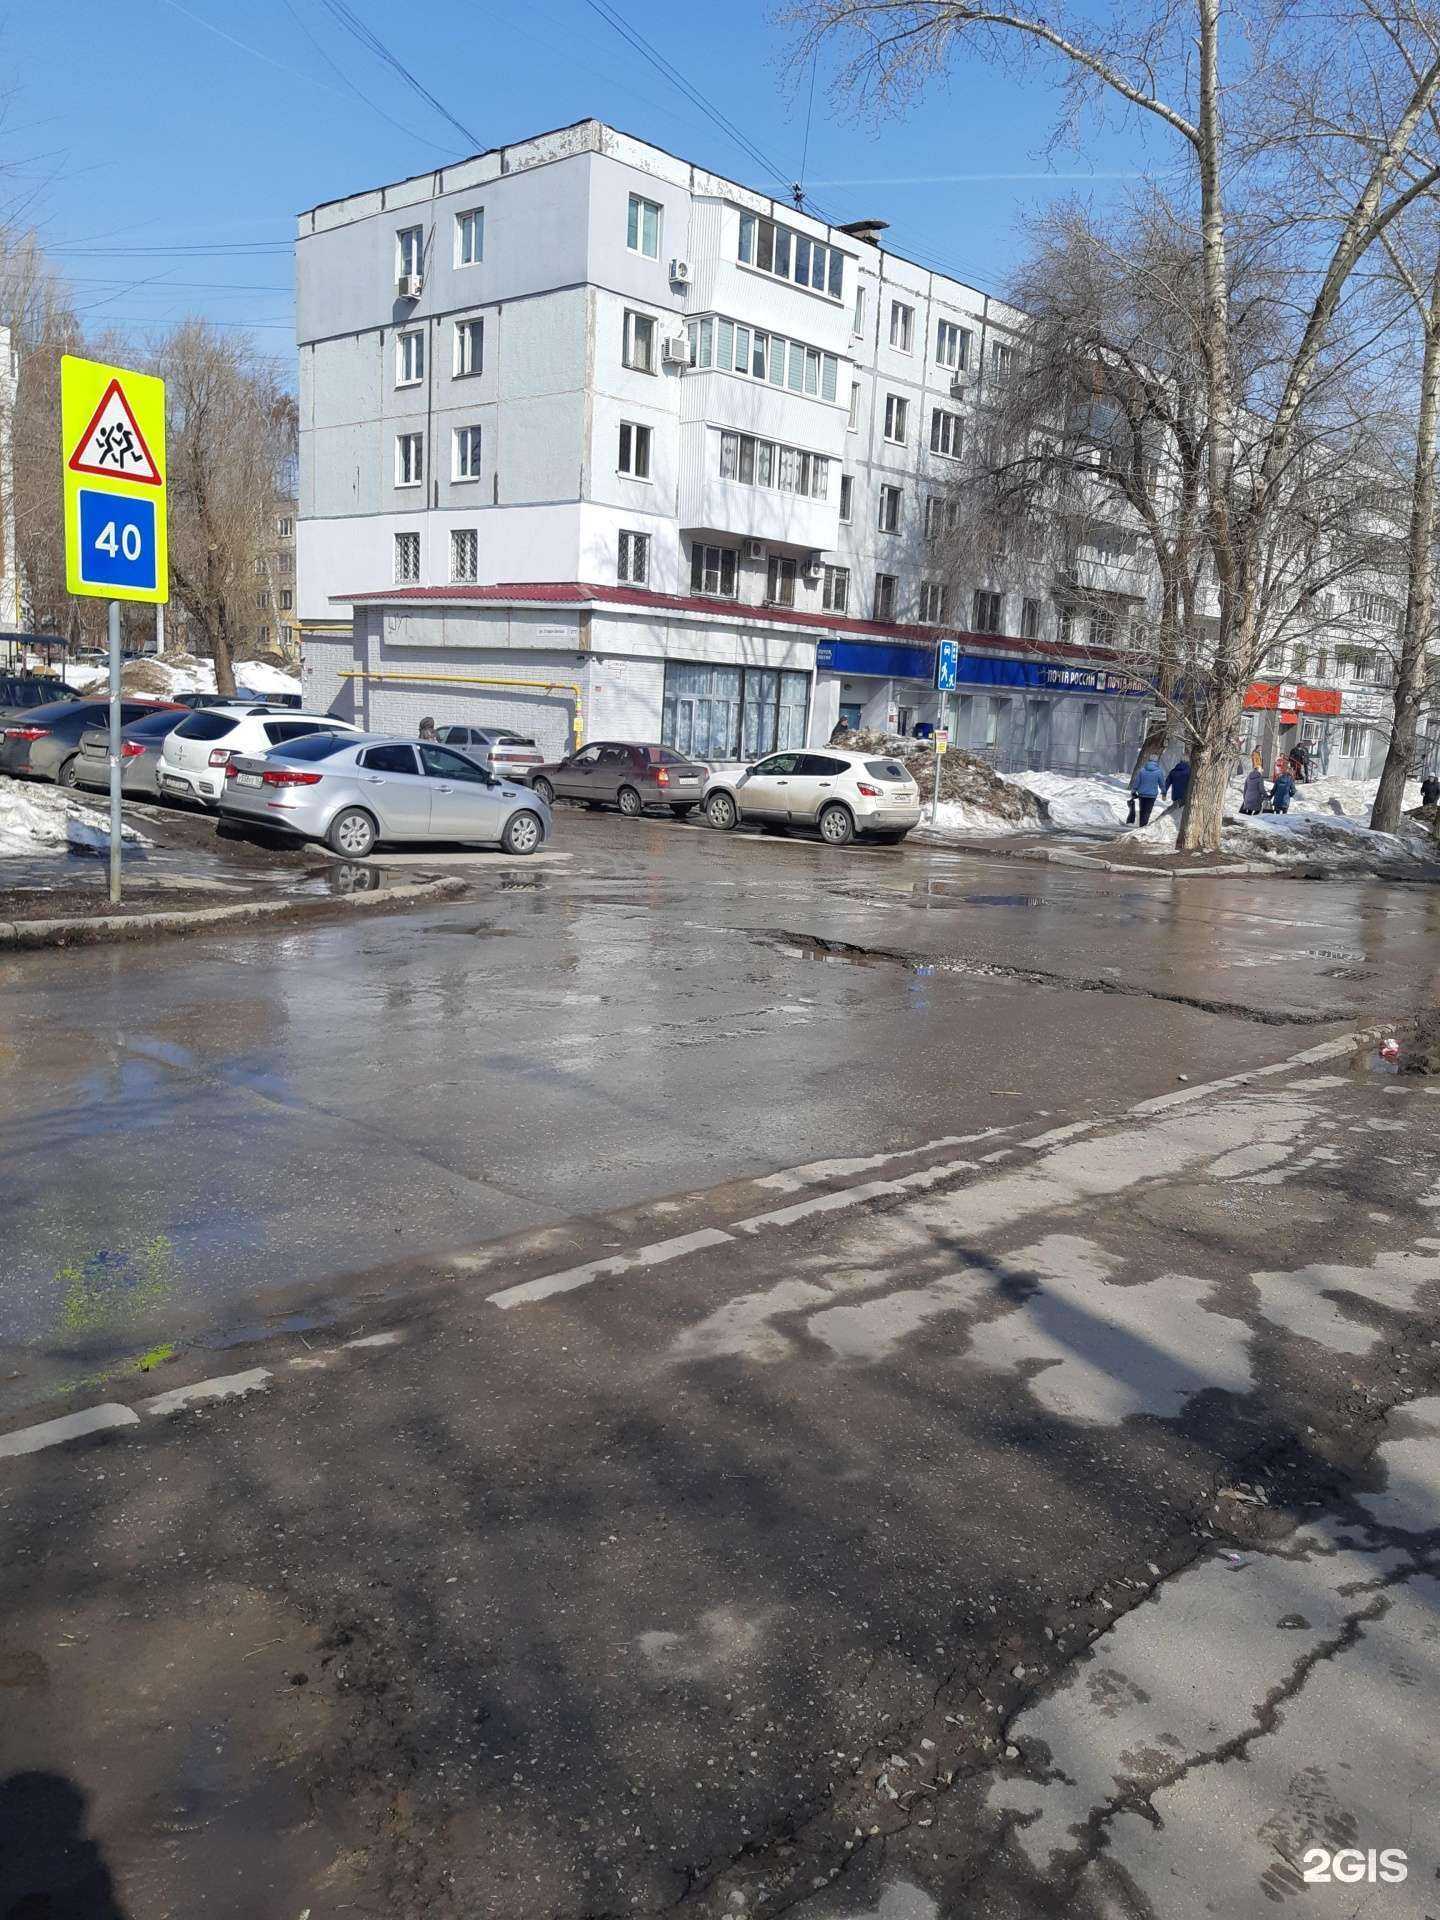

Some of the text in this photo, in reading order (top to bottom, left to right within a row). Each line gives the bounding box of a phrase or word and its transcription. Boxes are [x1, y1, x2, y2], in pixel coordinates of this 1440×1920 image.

[95, 521, 142, 561] 40
[1047, 669, 1095, 687] ПОЧТА РОССИИ
